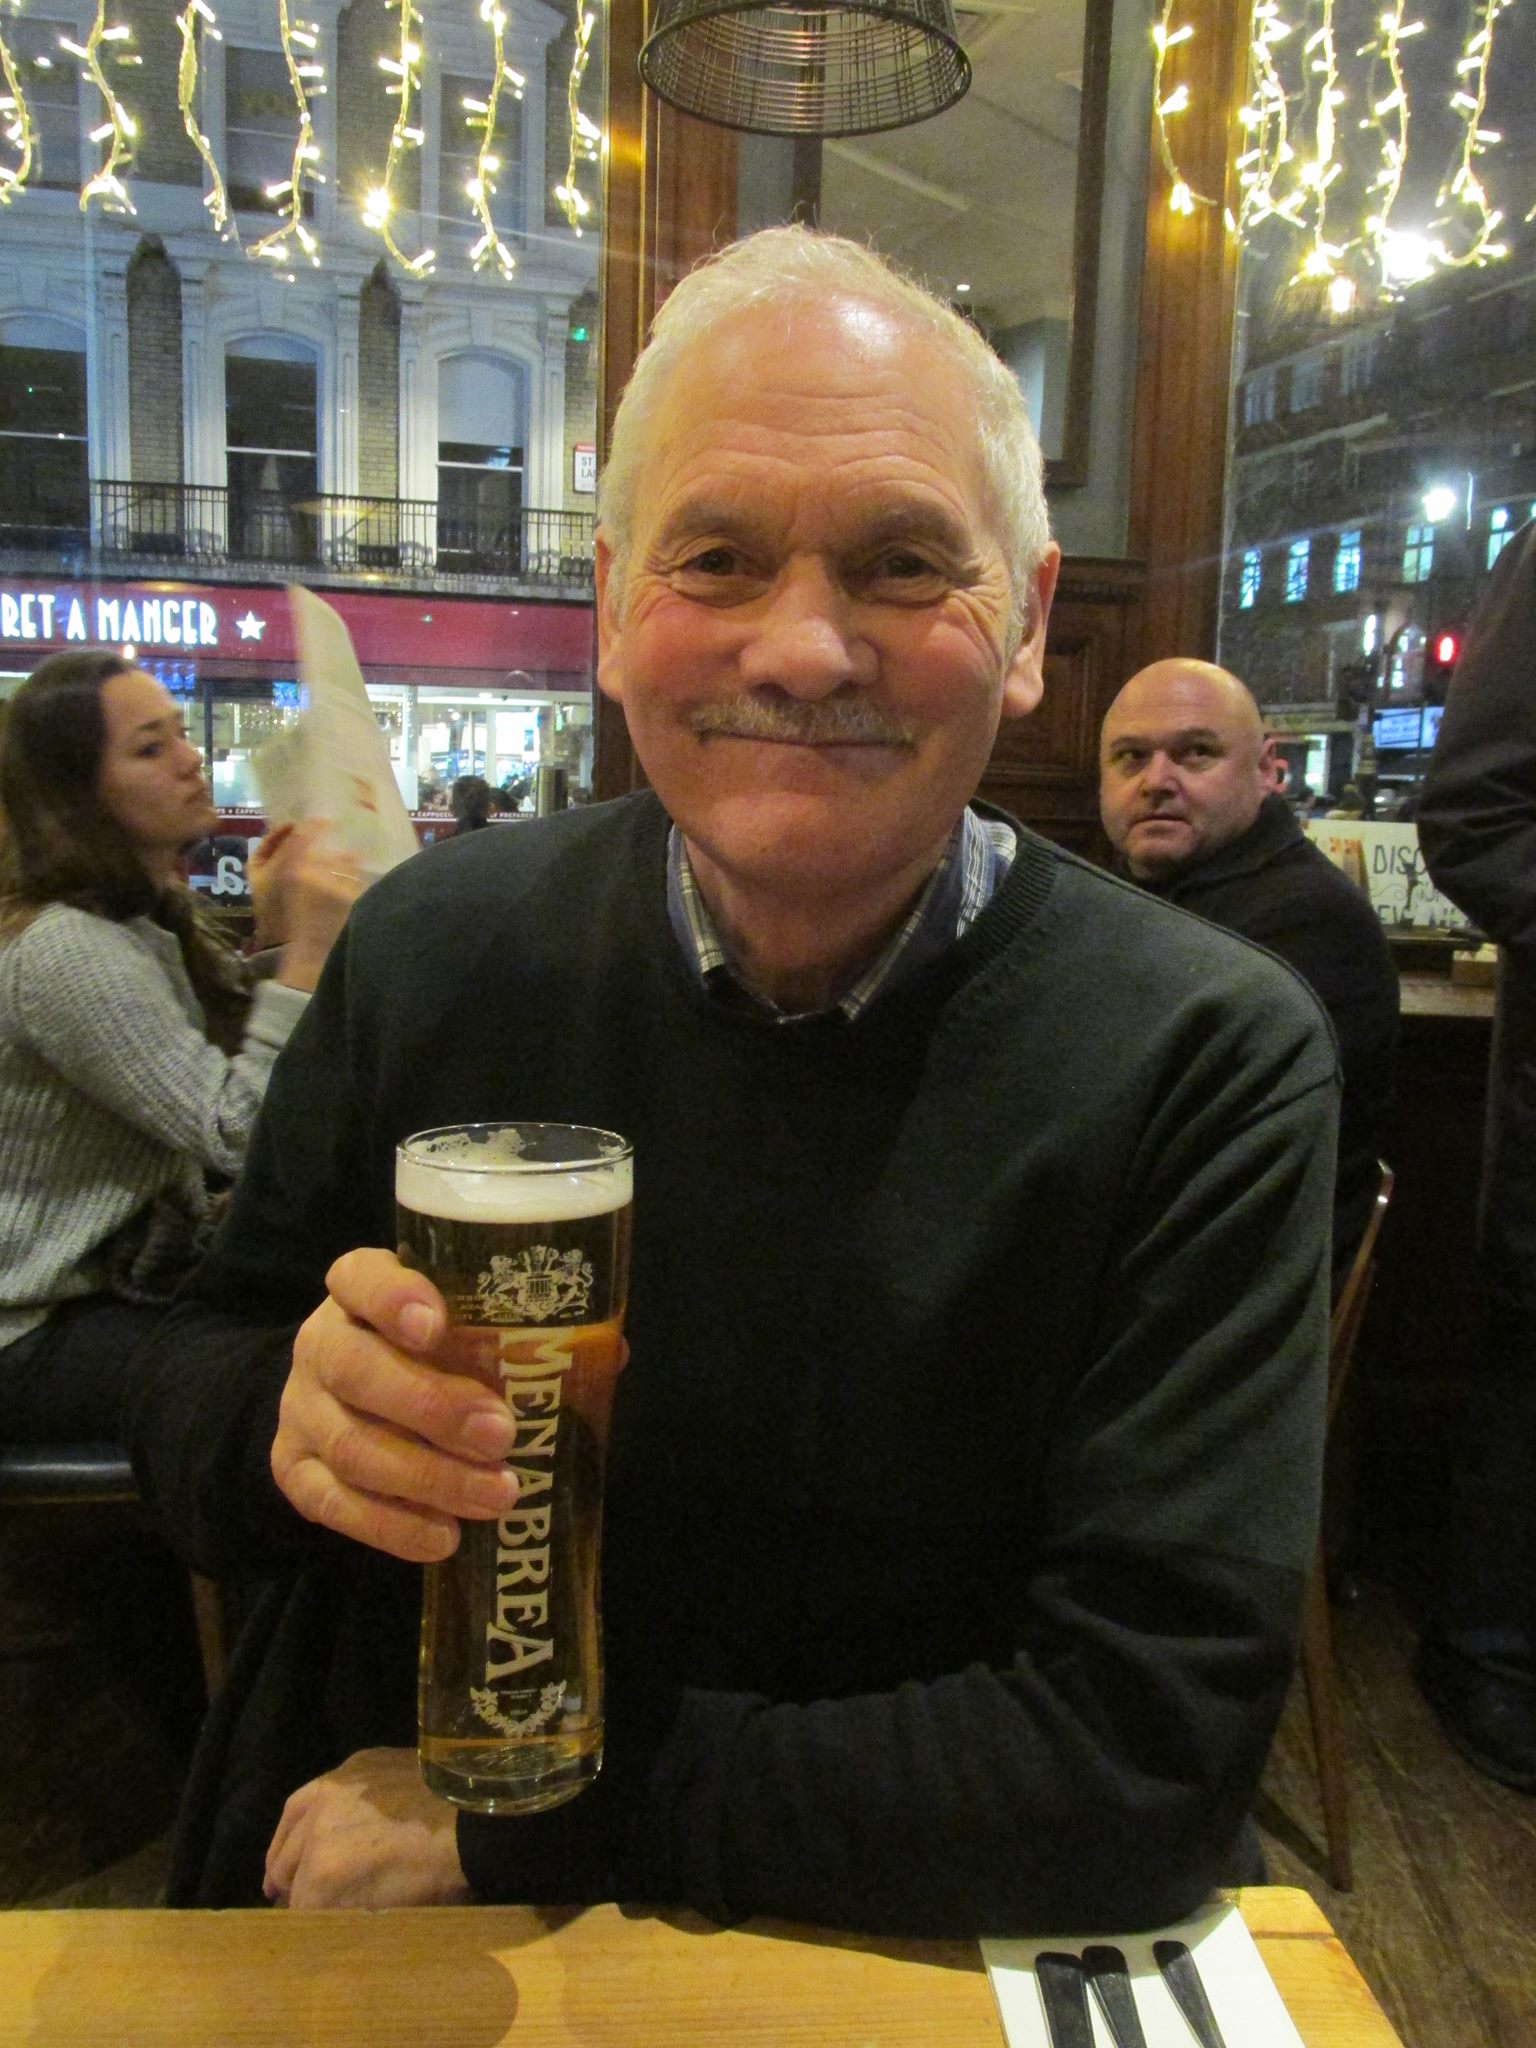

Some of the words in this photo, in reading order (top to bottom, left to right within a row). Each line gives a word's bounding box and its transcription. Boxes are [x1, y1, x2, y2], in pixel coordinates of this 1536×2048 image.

[66, 598, 87, 641] A
[97, 598, 218, 645] MANGER
[486, 1325, 575, 1683] MENABREA
